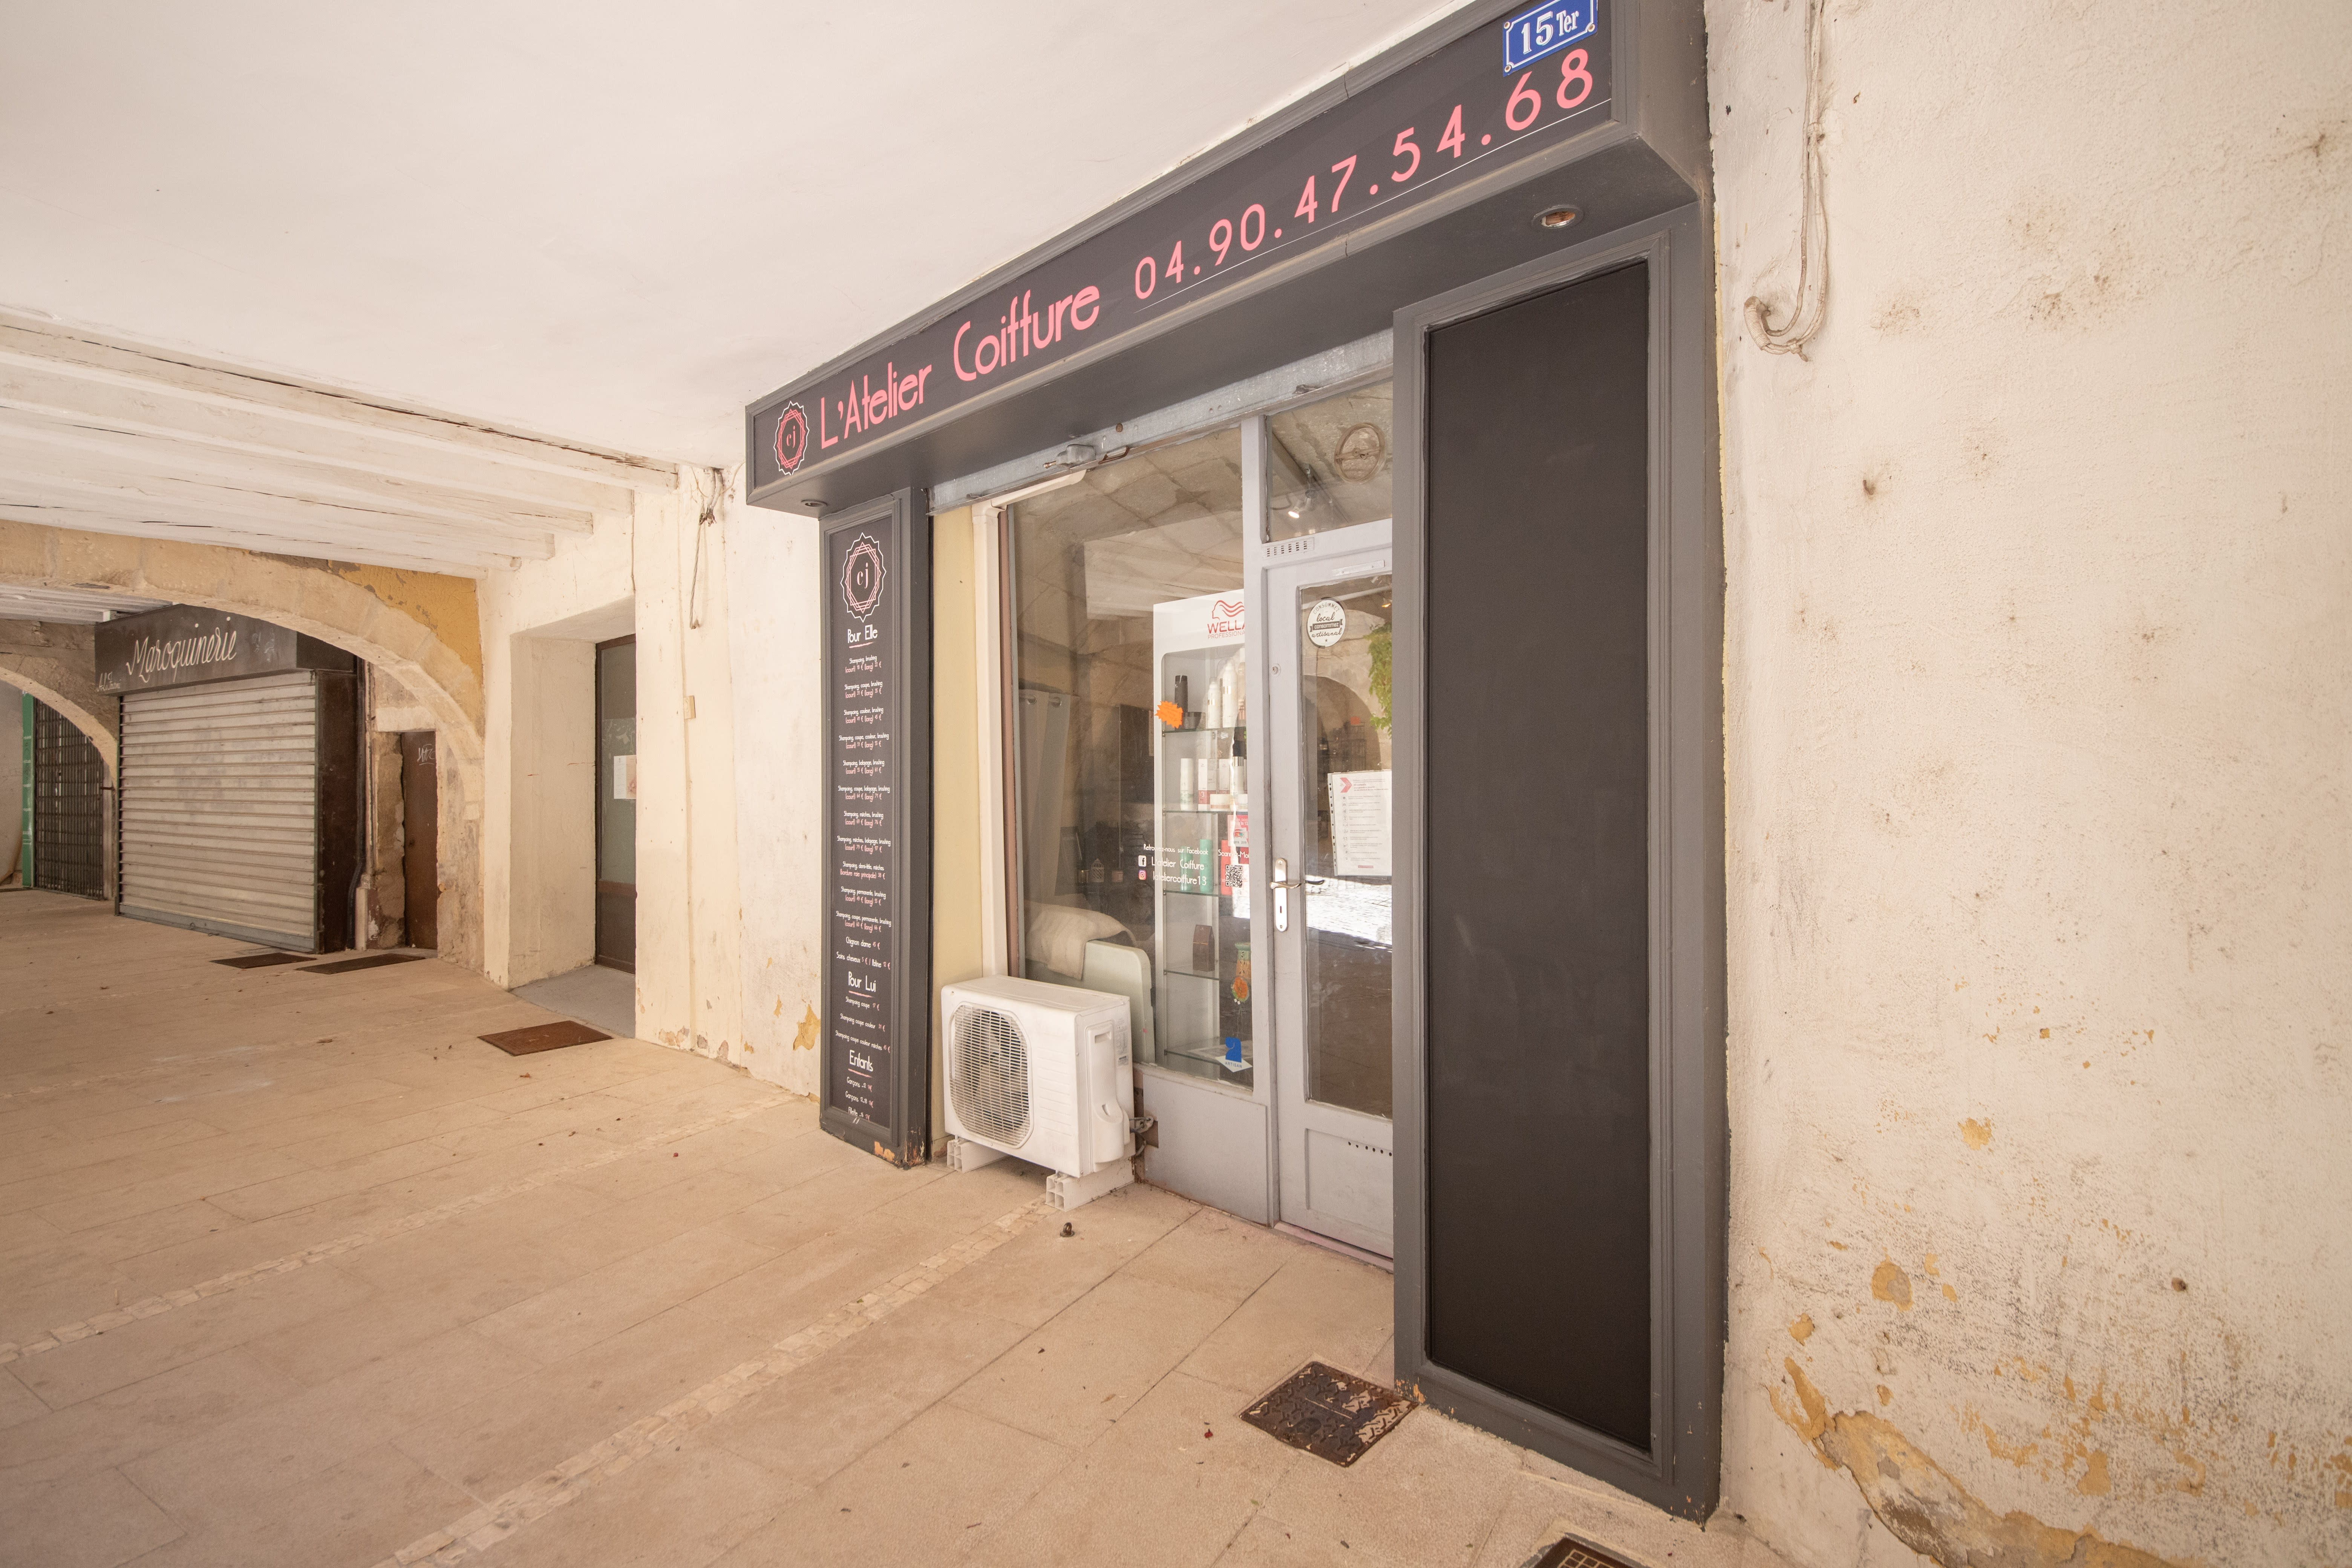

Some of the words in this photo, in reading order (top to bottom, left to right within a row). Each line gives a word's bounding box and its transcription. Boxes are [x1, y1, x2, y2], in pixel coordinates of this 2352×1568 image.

[1522, 11, 1553, 54] 15
[1556, 10, 1579, 36] Ter
[821, 362, 931, 449] L'Atelier
[954, 286, 1099, 381] Coiffure
[1135, 49, 1592, 299] 04.90.47.54.68
[1313, 602, 1339, 614] CONSOMMEZ
[1317, 612, 1335, 622] local
[848, 629, 861, 643] Pour
[865, 624, 877, 640] Elle
[1312, 628, 1342, 637] artisanal
[126, 617, 237, 683] Maroquinerie
[879, 838, 891, 847] brushing
[1143, 844, 1175, 852] Retrouvez-nous
[1218, 849, 1249, 858] Scannz-Moi
[1152, 856, 1176, 868] L'atelier
[1180, 859, 1205, 870] Coiffure
[874, 890, 886, 900] brushing
[879, 918, 891, 927] brushing
[846, 936, 859, 947] Chignon
[861, 940, 871, 948] dame
[836, 951, 845, 960] Soins
[847, 954, 861, 963] cheveux
[848, 971, 862, 988] Pour
[865, 975, 876, 992] Lui
[850, 1049, 873, 1072] Enfants
